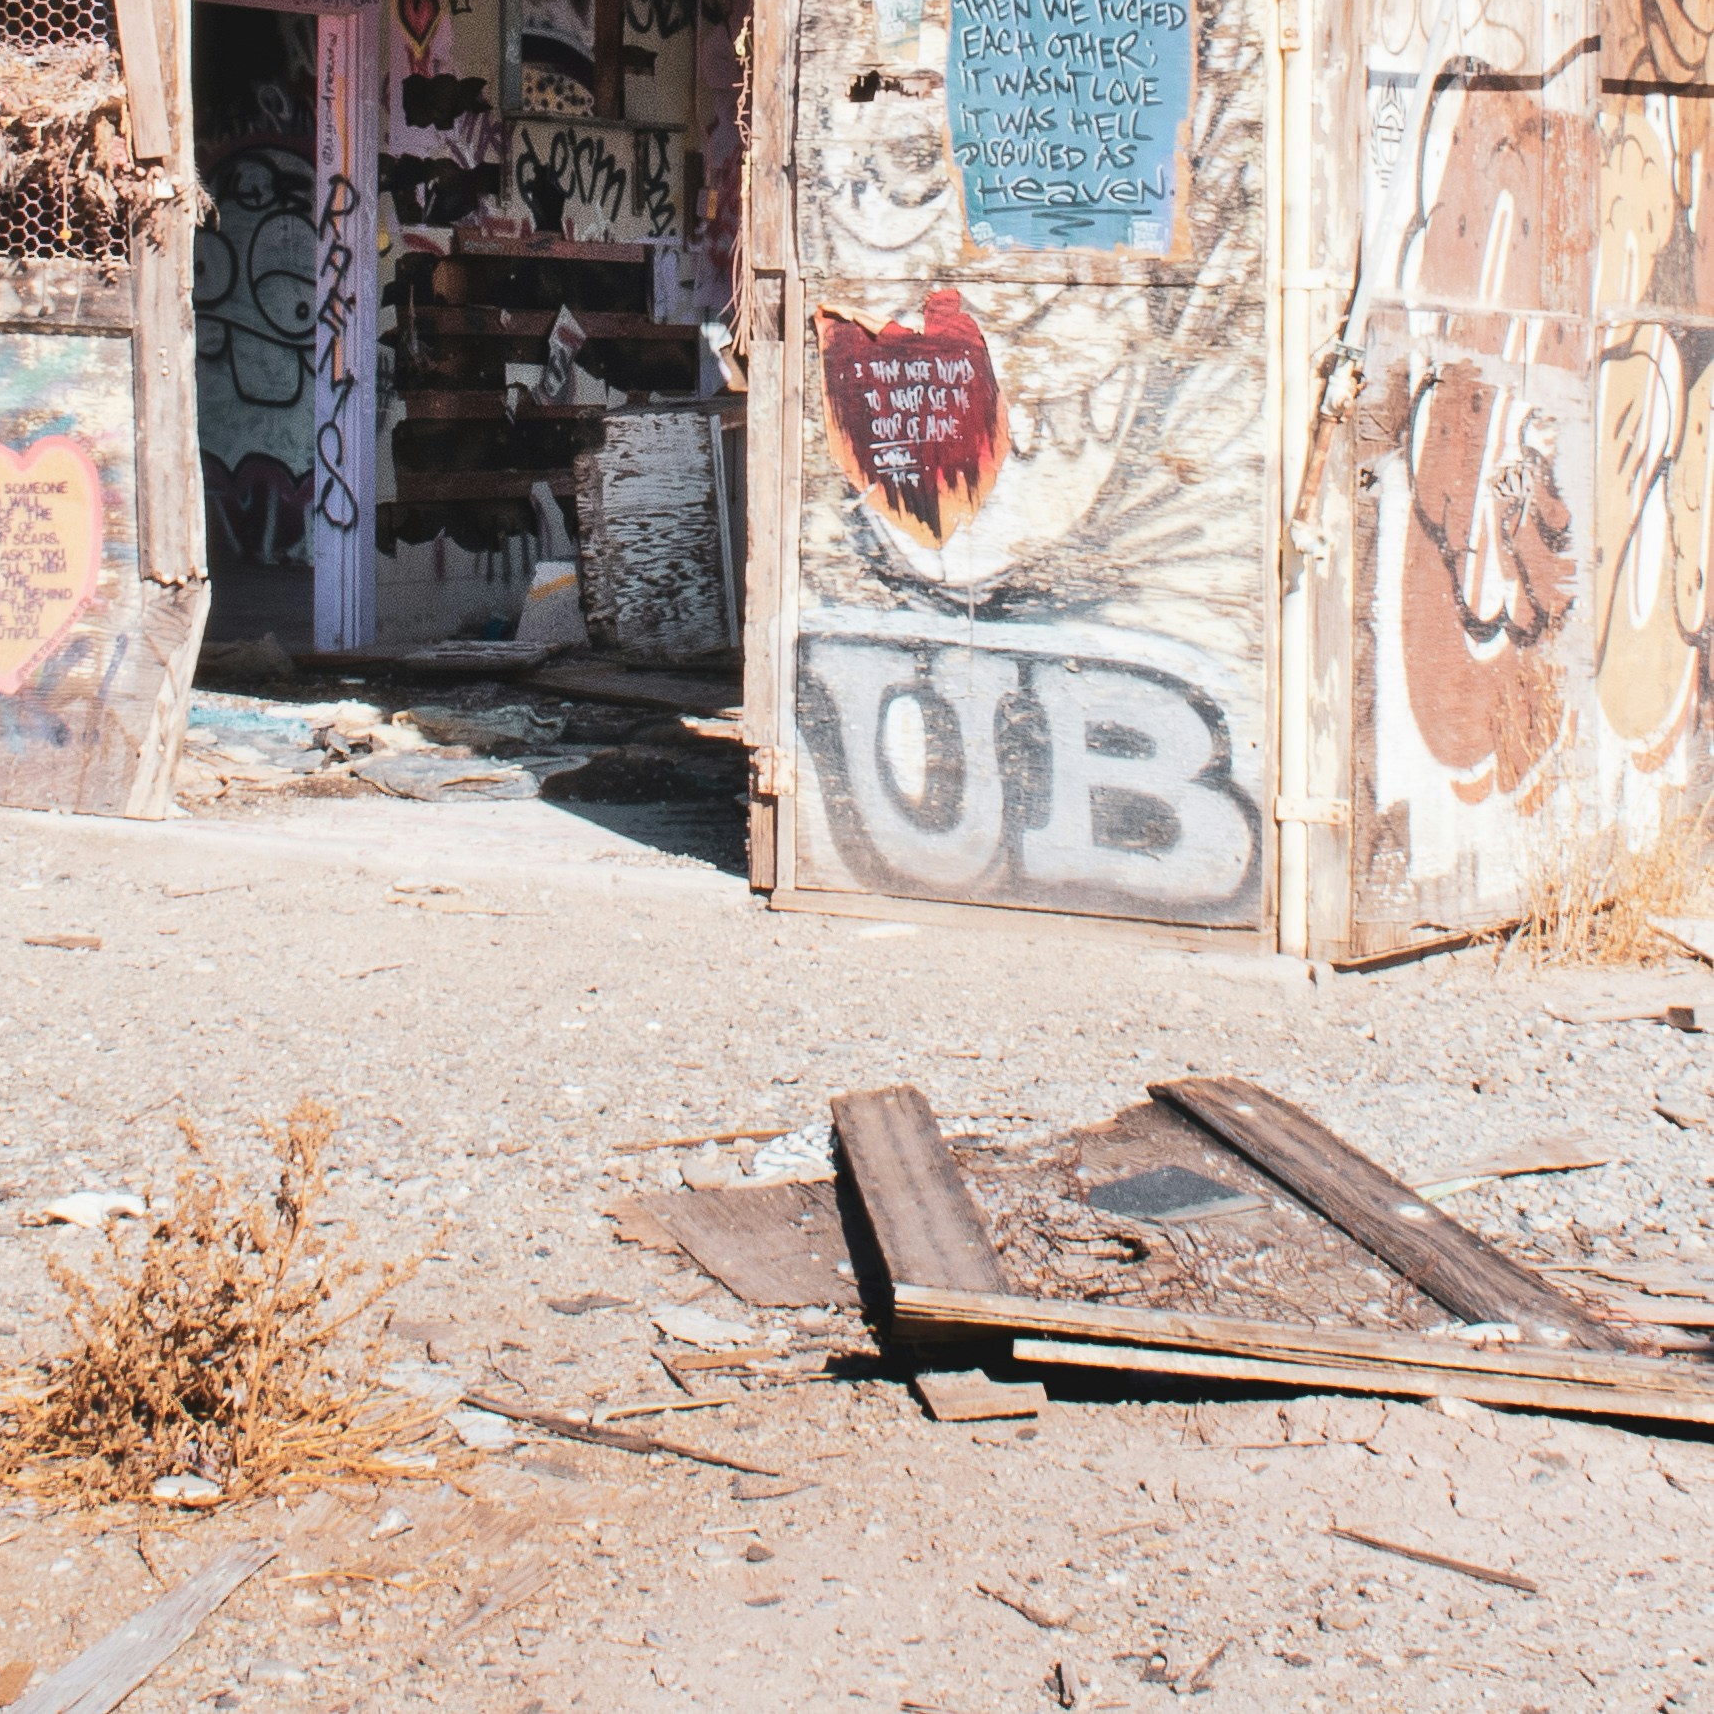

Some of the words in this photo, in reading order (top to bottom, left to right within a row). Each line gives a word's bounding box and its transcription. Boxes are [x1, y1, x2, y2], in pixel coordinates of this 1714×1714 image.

[961, 24, 1038, 62] EACH
[1089, 74, 1163, 106] LOVE
[994, 106, 1058, 140] WAS
[1067, 108, 1153, 142] HELL
[1093, 143, 1137, 172] AS
[864, 389, 881, 411] TO
[5, 481, 68, 494] SOMEONE
[39, 548, 66, 561] YOU
